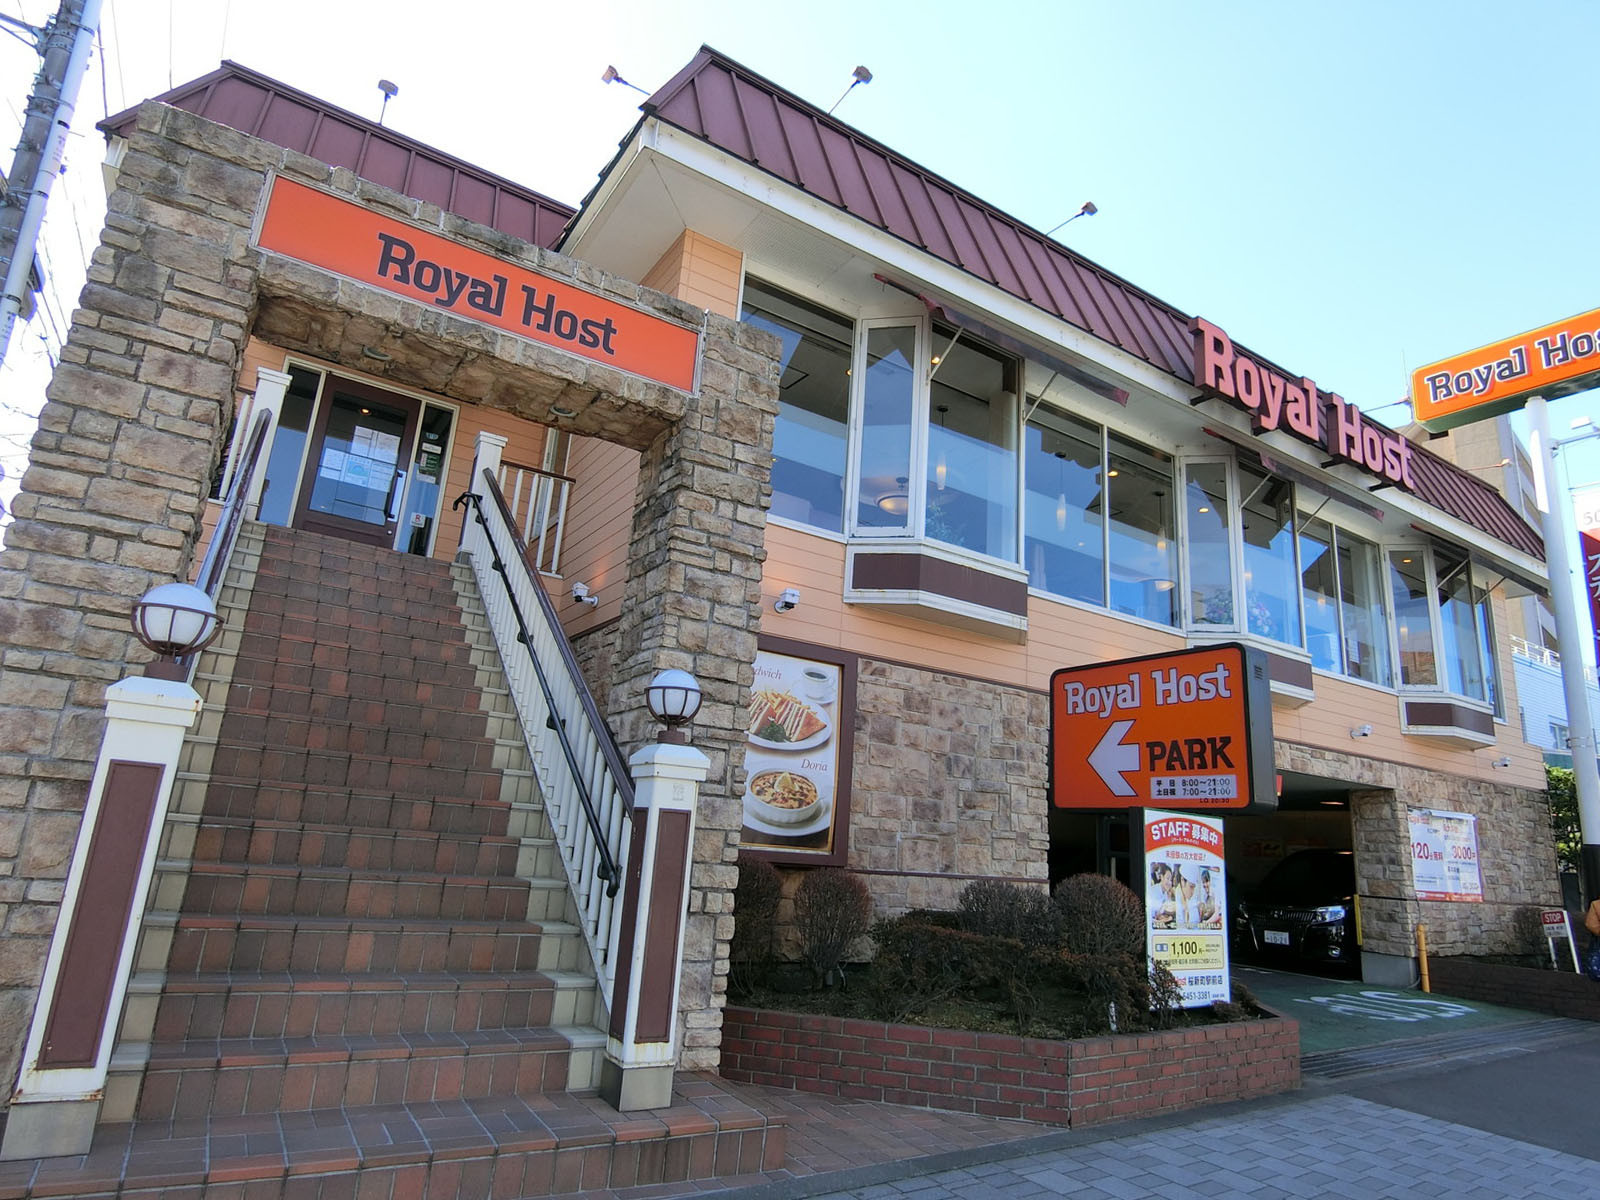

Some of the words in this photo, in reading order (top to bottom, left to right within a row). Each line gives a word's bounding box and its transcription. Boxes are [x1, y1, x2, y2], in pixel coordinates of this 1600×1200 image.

[377, 233, 508, 316] Royal
[521, 285, 617, 356] Host
[1424, 346, 1528, 404] Royal
[1190, 316, 1320, 444] Royal
[1326, 392, 1415, 492] Host
[754, 665, 782, 680] dwich
[1063, 672, 1141, 718] Royal
[1151, 663, 1232, 706] Host
[801, 758, 828, 772] Doria
[1146, 736, 1235, 772] PARK
[1151, 821, 1190, 841] STAFF
[1191, 823, 1219, 846] 募集中
[1544, 913, 1562, 923] STOP
